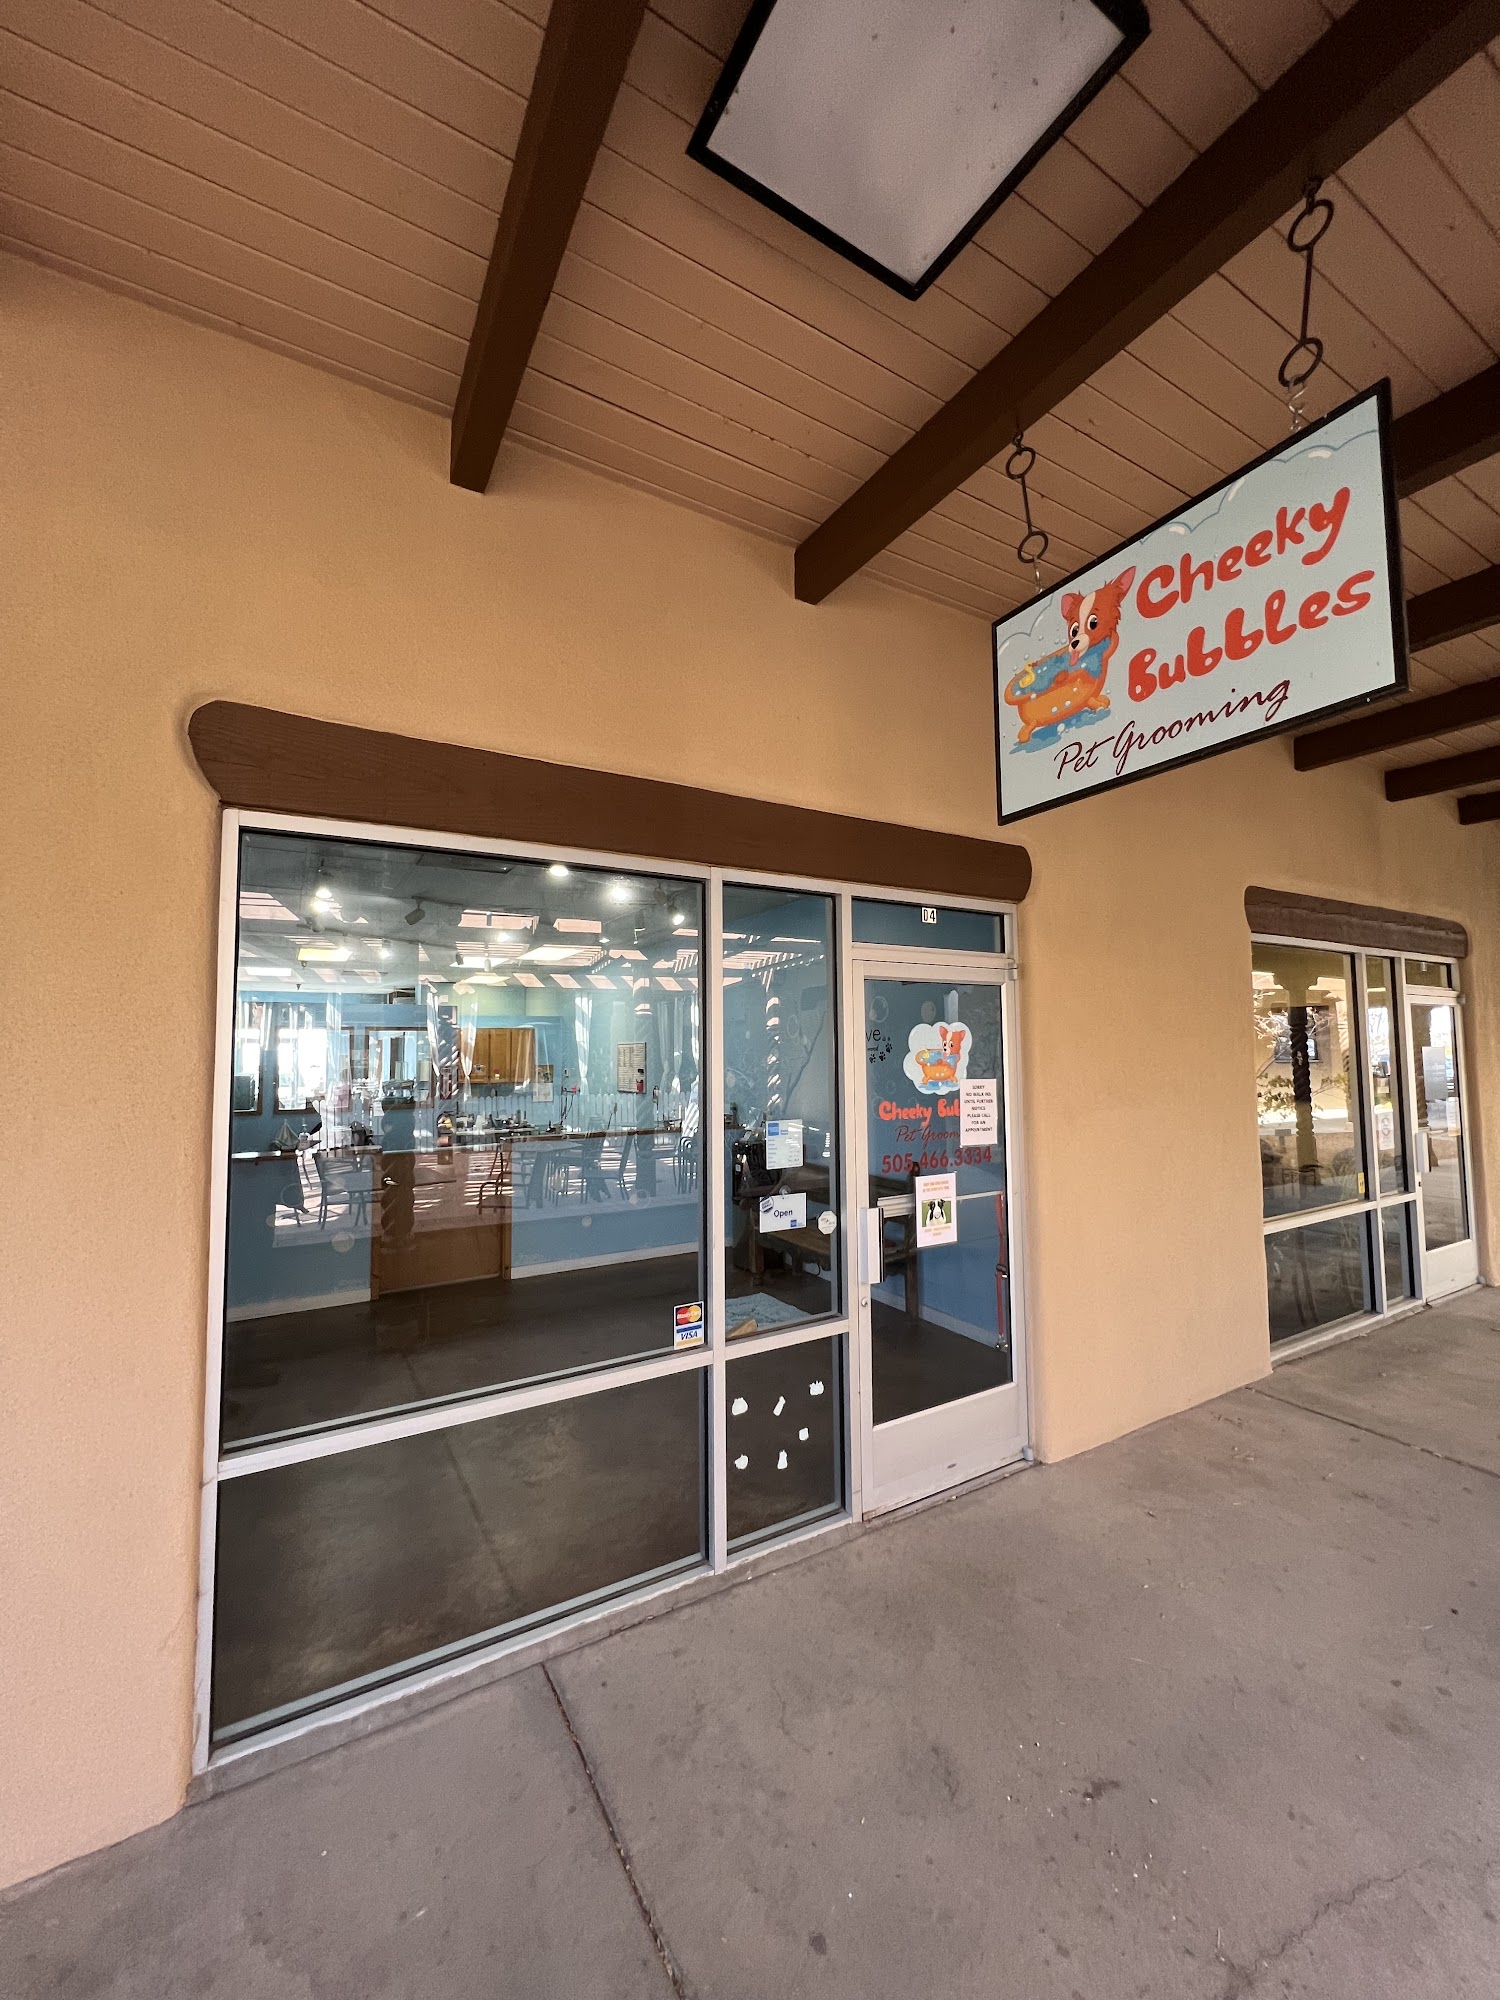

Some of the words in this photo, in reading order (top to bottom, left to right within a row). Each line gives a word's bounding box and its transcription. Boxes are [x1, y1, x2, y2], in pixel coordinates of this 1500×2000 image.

[1136, 486, 1351, 619] Cheeky
[1127, 570, 1375, 702] Bubbles
[1053, 735, 1115, 780] Pet
[1111, 680, 1291, 776] Grooming
[878, 1100, 933, 1127] Cheeky
[895, 1125, 923, 1142] Pet
[921, 1123, 960, 1150] Groom
[881, 1145, 992, 1174] 505.466.3334
[773, 1209, 793, 1219] Open
[681, 1330, 698, 1341] VISA
